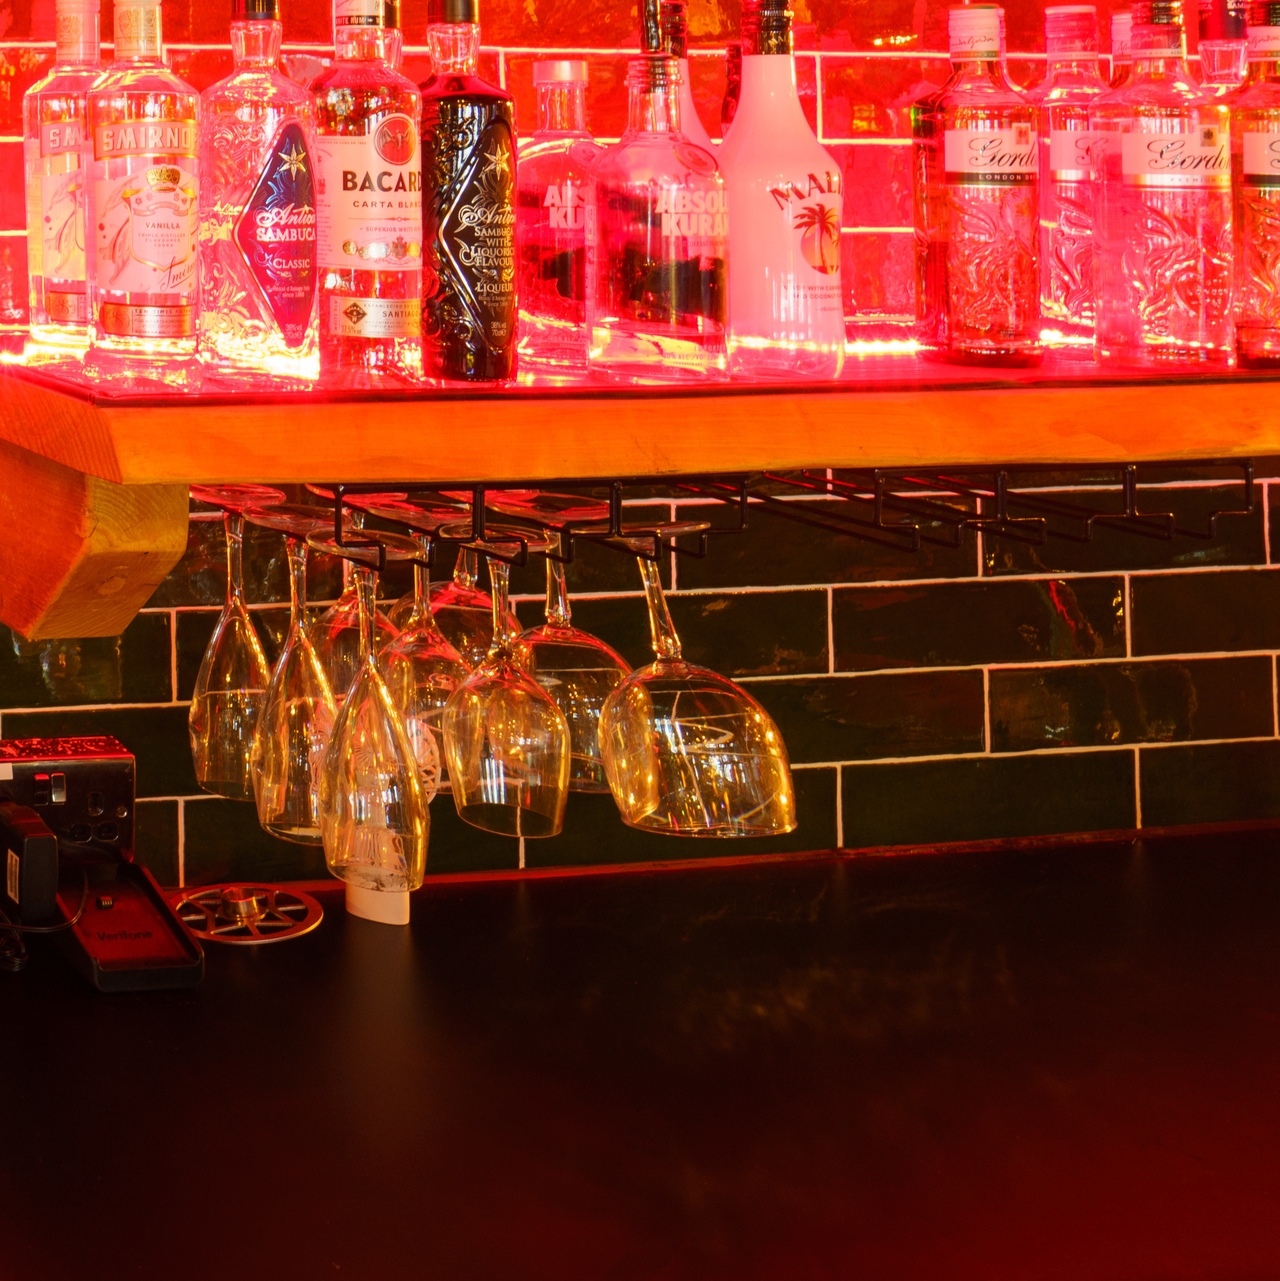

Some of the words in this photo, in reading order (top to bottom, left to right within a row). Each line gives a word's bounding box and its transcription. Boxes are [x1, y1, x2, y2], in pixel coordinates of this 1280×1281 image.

[978, 172, 1024, 181] LONDON
[145, 221, 181, 230] VANILLA
[272, 257, 311, 269] CLASSIC
[96, 928, 153, 948] Verifone
